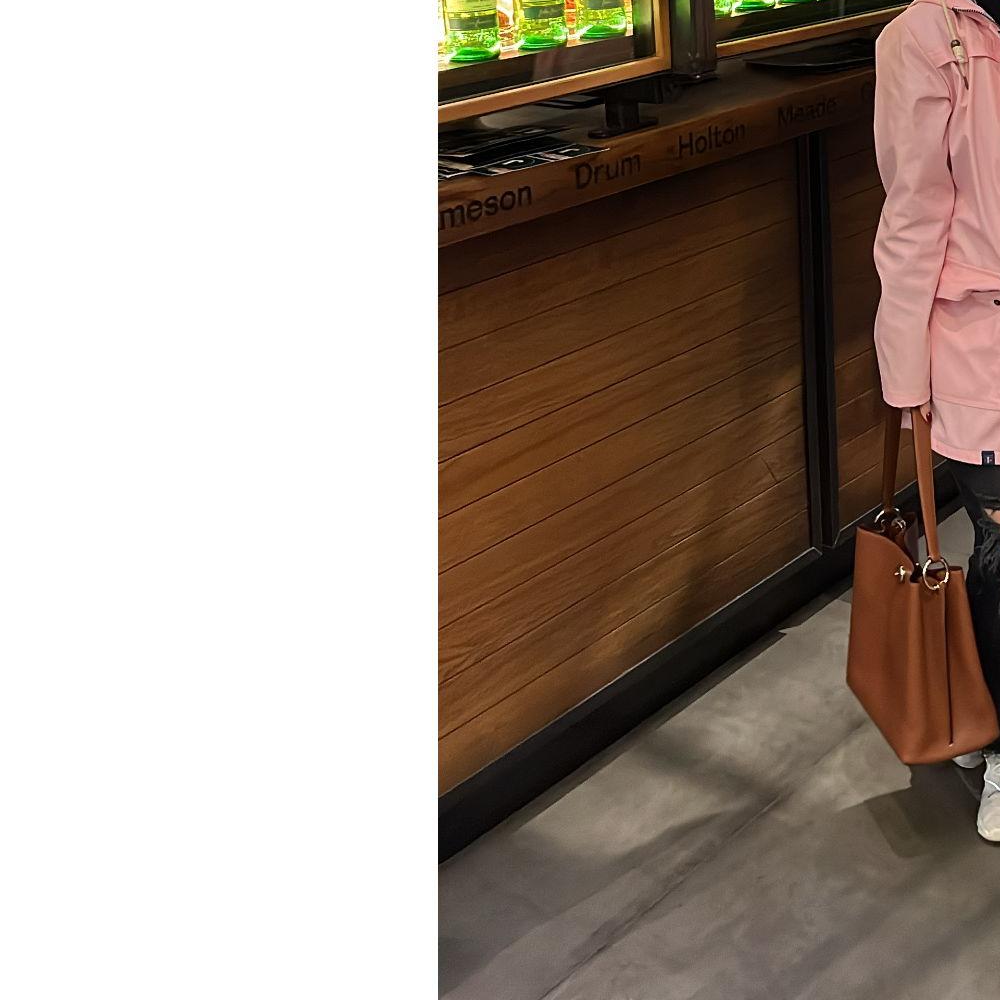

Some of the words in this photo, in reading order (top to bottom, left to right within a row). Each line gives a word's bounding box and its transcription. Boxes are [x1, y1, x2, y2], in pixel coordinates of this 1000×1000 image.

[677, 122, 746, 161] Holton
[574, 153, 642, 190] Drum
[438, 185, 533, 231] meson
